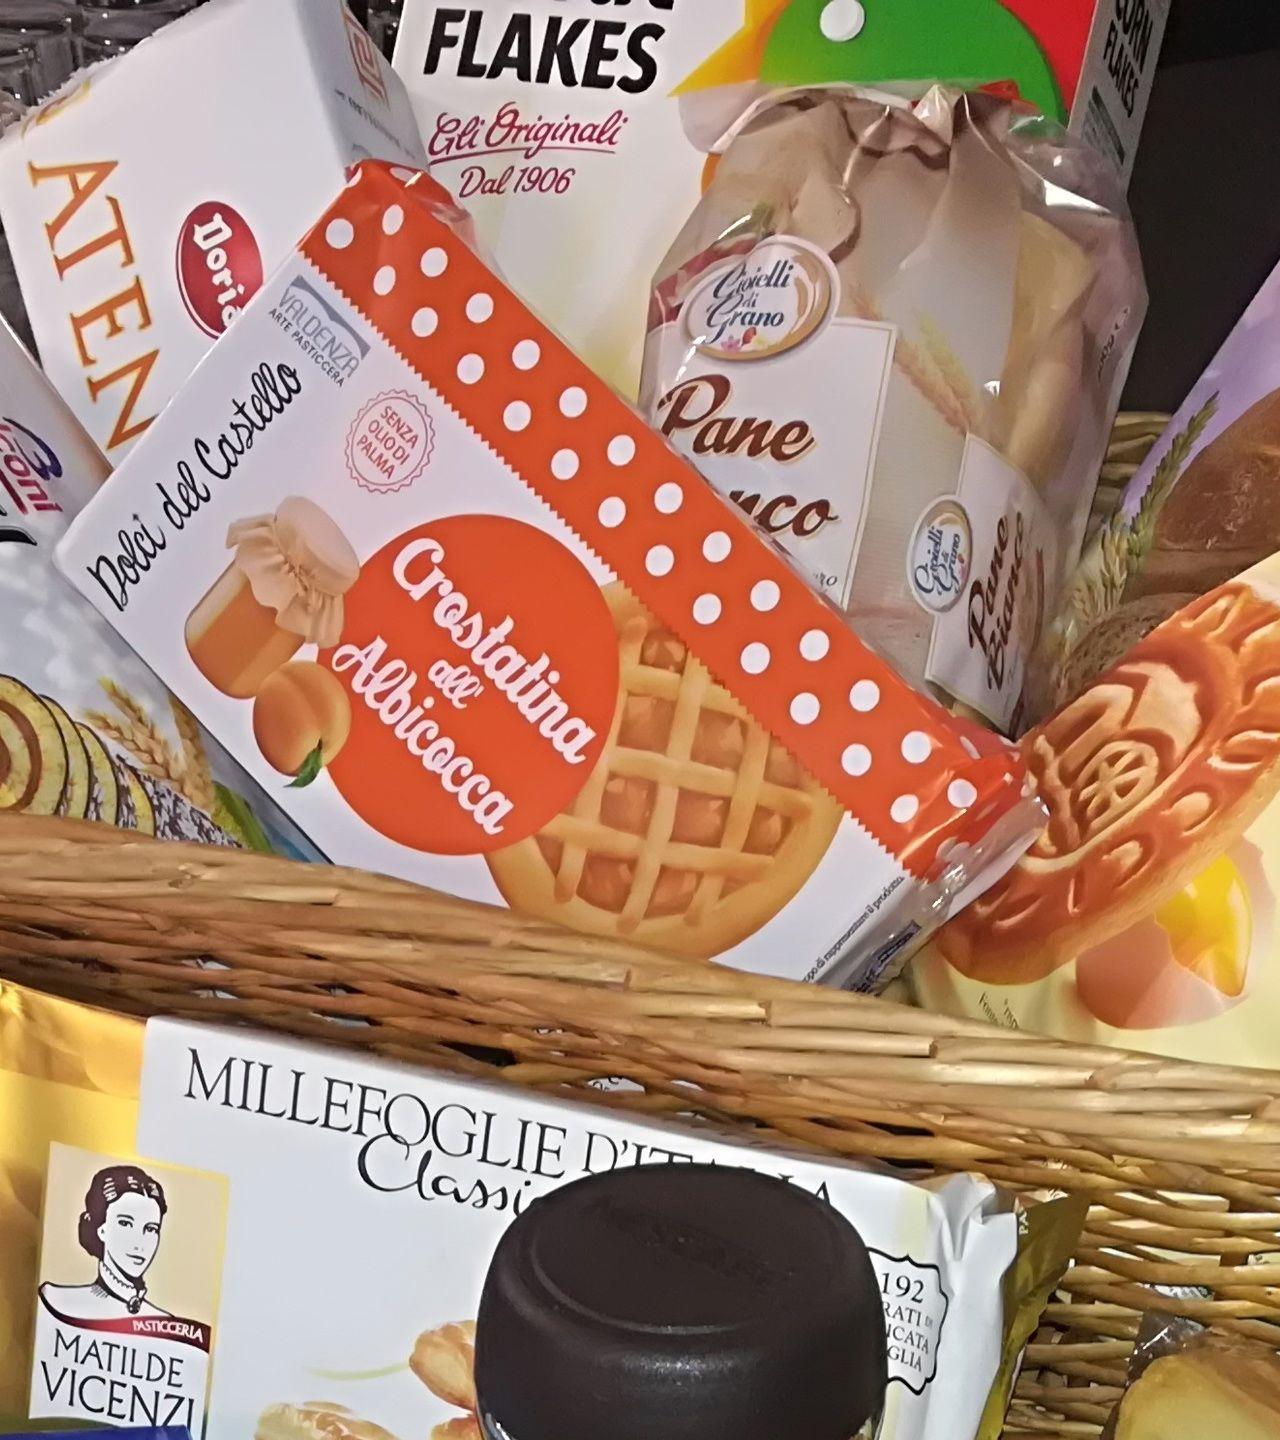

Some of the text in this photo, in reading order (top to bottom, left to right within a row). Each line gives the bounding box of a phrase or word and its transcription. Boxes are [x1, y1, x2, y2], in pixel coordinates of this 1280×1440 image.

[423, 8, 666, 94] FLAKES
[427, 112, 485, 156] Gli
[485, 101, 628, 160] Originali
[459, 165, 576, 198] Dal 1906
[28, 160, 161, 450] ATEN
[713, 259, 794, 300] Gioielli
[268, 308, 345, 388] ARTE PASTICCERA
[279, 287, 360, 379] VALDENZA
[705, 294, 785, 344] Grano
[368, 419, 410, 465] OLIO DI
[380, 405, 419, 450] SENZA
[656, 374, 815, 462] Pane
[89, 361, 303, 613] Dolci del Castello
[357, 434, 395, 480] PALMA
[968, 515, 1008, 657] Pane
[393, 538, 597, 764] Crostatina
[428, 660, 485, 710] all'
[331, 635, 515, 836] Albicocca
[183, 1047, 567, 1180] MILLEFOGLIE
[358, 1132, 532, 1220] Classi
[881, 1272, 924, 1304] 192
[54, 1328, 184, 1388] MATILDE
[132, 1319, 203, 1343] PASTICCERIA
[41, 1360, 194, 1429] VICENZI
